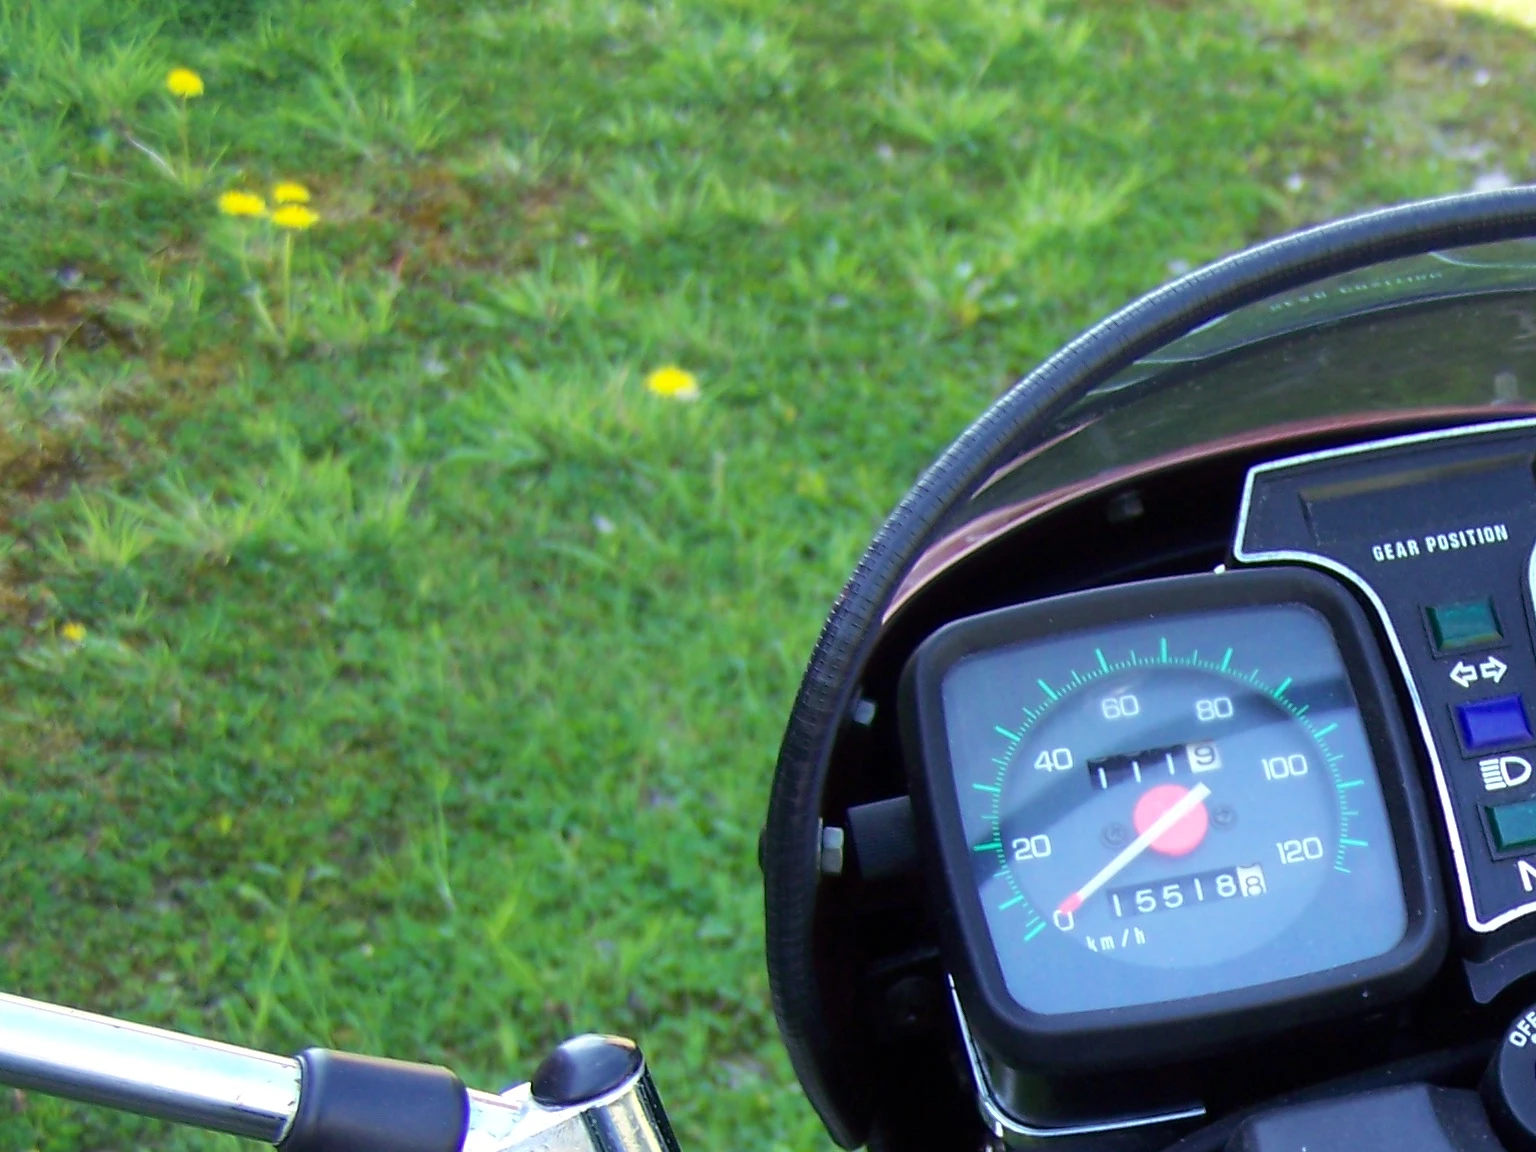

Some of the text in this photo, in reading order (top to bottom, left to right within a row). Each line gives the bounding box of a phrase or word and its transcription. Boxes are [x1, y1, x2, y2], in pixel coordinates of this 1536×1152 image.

[1372, 524, 1509, 562] GEAR POSITION
[1102, 695, 1139, 721] 60
[1197, 696, 1233, 722] 80
[1034, 747, 1073, 772] 40
[1261, 753, 1308, 781] 100
[1012, 835, 1052, 861] 20
[1276, 836, 1323, 867] 120
[1086, 927, 1146, 952] km/h
